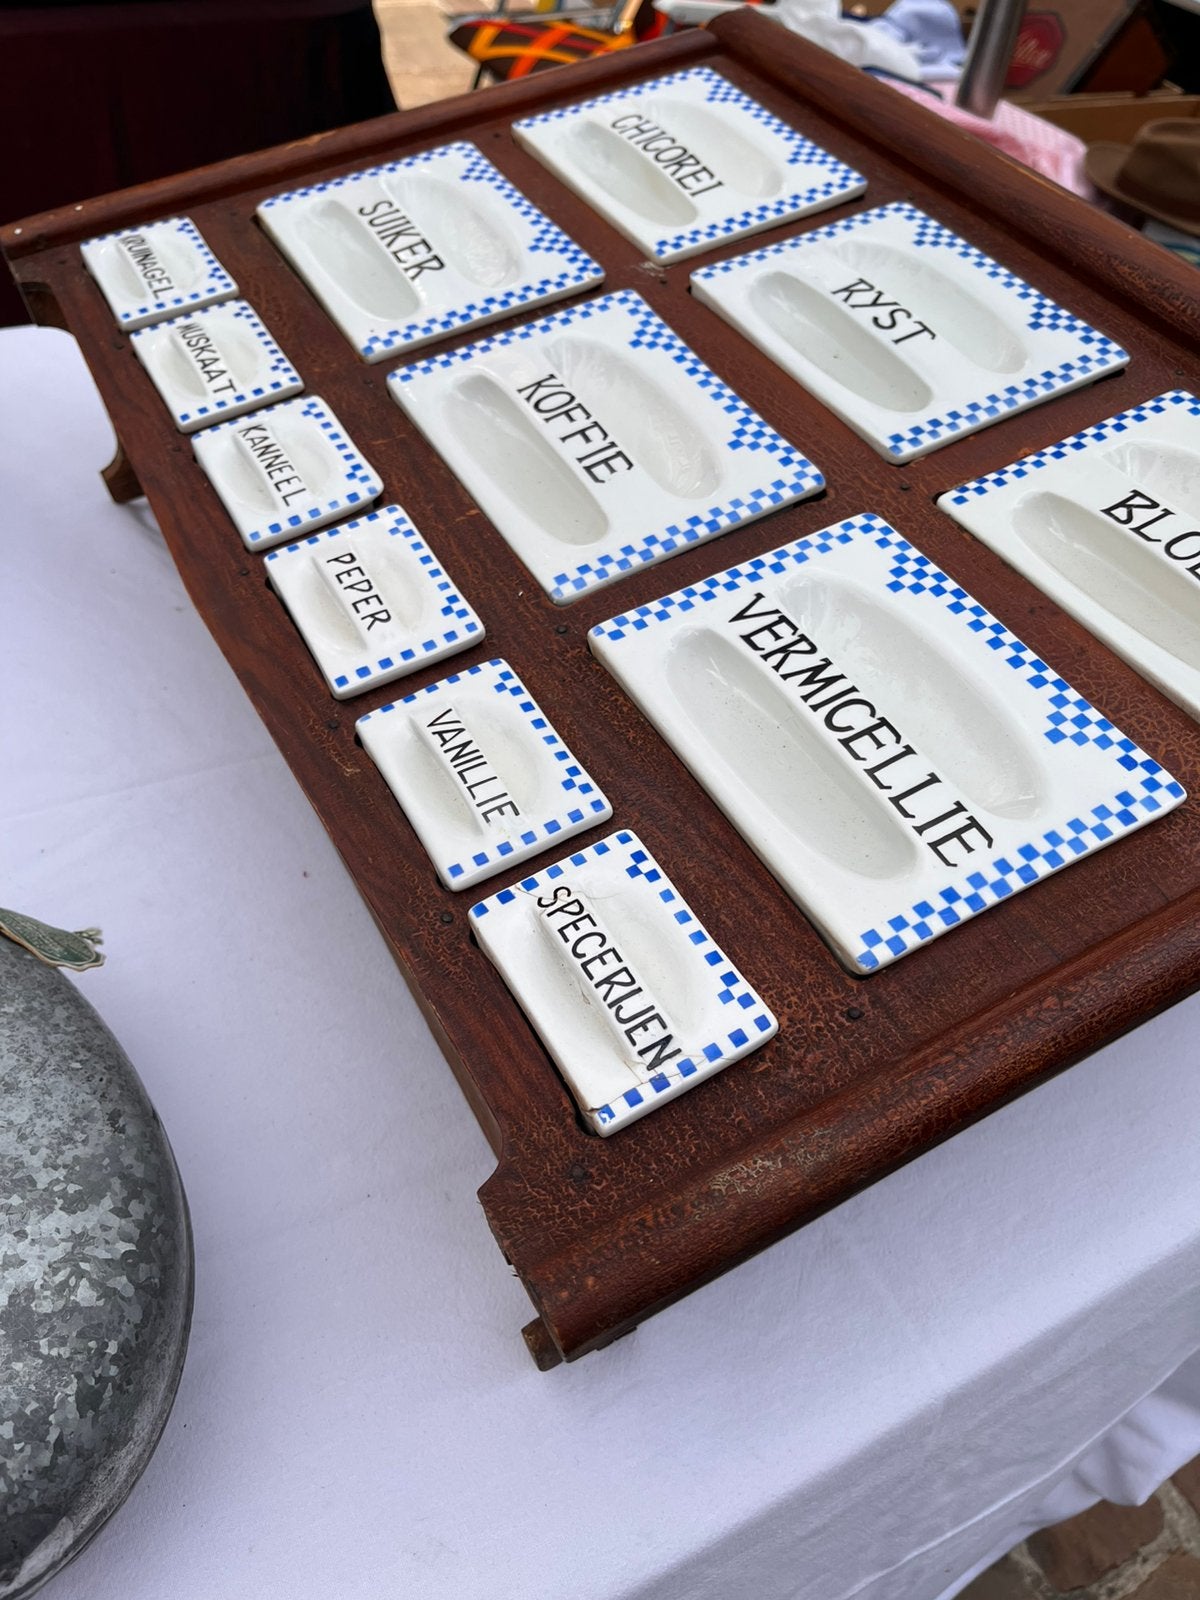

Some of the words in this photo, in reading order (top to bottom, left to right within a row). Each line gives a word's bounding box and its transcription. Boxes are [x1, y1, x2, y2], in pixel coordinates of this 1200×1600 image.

[610, 114, 724, 197] CHICOREI
[358, 200, 446, 281] SUIKER
[830, 278, 936, 344] RYST
[176, 323, 237, 393] MUSKAAT
[238, 424, 307, 507] KANNEEL
[516, 373, 634, 484] KOFFIE
[326, 552, 392, 631] PEPER
[427, 708, 520, 824] VANILLIE
[728, 592, 994, 867] VERMICELLIE
[537, 886, 682, 1071] SPECERIJEN
